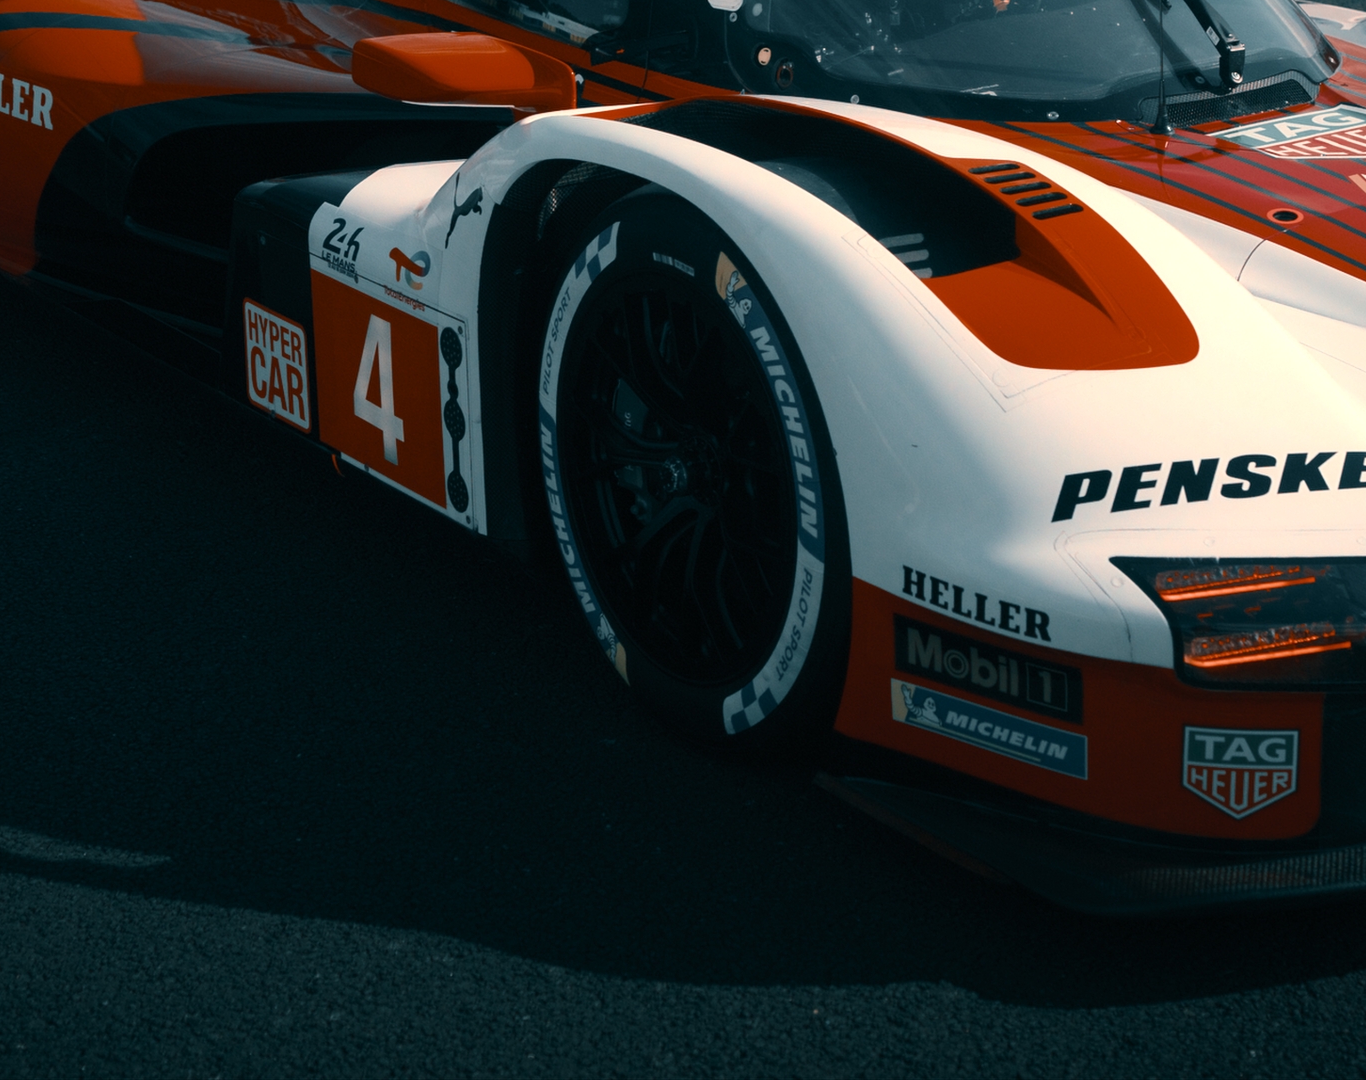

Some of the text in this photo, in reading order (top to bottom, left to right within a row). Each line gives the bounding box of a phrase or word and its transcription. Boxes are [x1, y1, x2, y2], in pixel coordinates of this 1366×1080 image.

[1224, 111, 1366, 144] TAG
[321, 250, 332, 261] LE
[332, 255, 356, 274] MANS
[322, 218, 365, 262] 24h
[247, 308, 303, 367] HYPER
[550, 289, 572, 342] SPORT
[250, 345, 307, 422] CAR
[352, 313, 406, 467] 4
[542, 345, 555, 396] PILOT
[750, 326, 819, 541] MICHELIN
[539, 421, 597, 615] MICHELIN
[796, 567, 813, 626] PILOT
[902, 565, 1052, 642] HELLER
[775, 626, 804, 682] SPORT
[906, 626, 1020, 698] Mobil
[945, 710, 1069, 761] MICHELIN
[1194, 733, 1288, 764] TAG
[1189, 766, 1290, 812] HEUER
